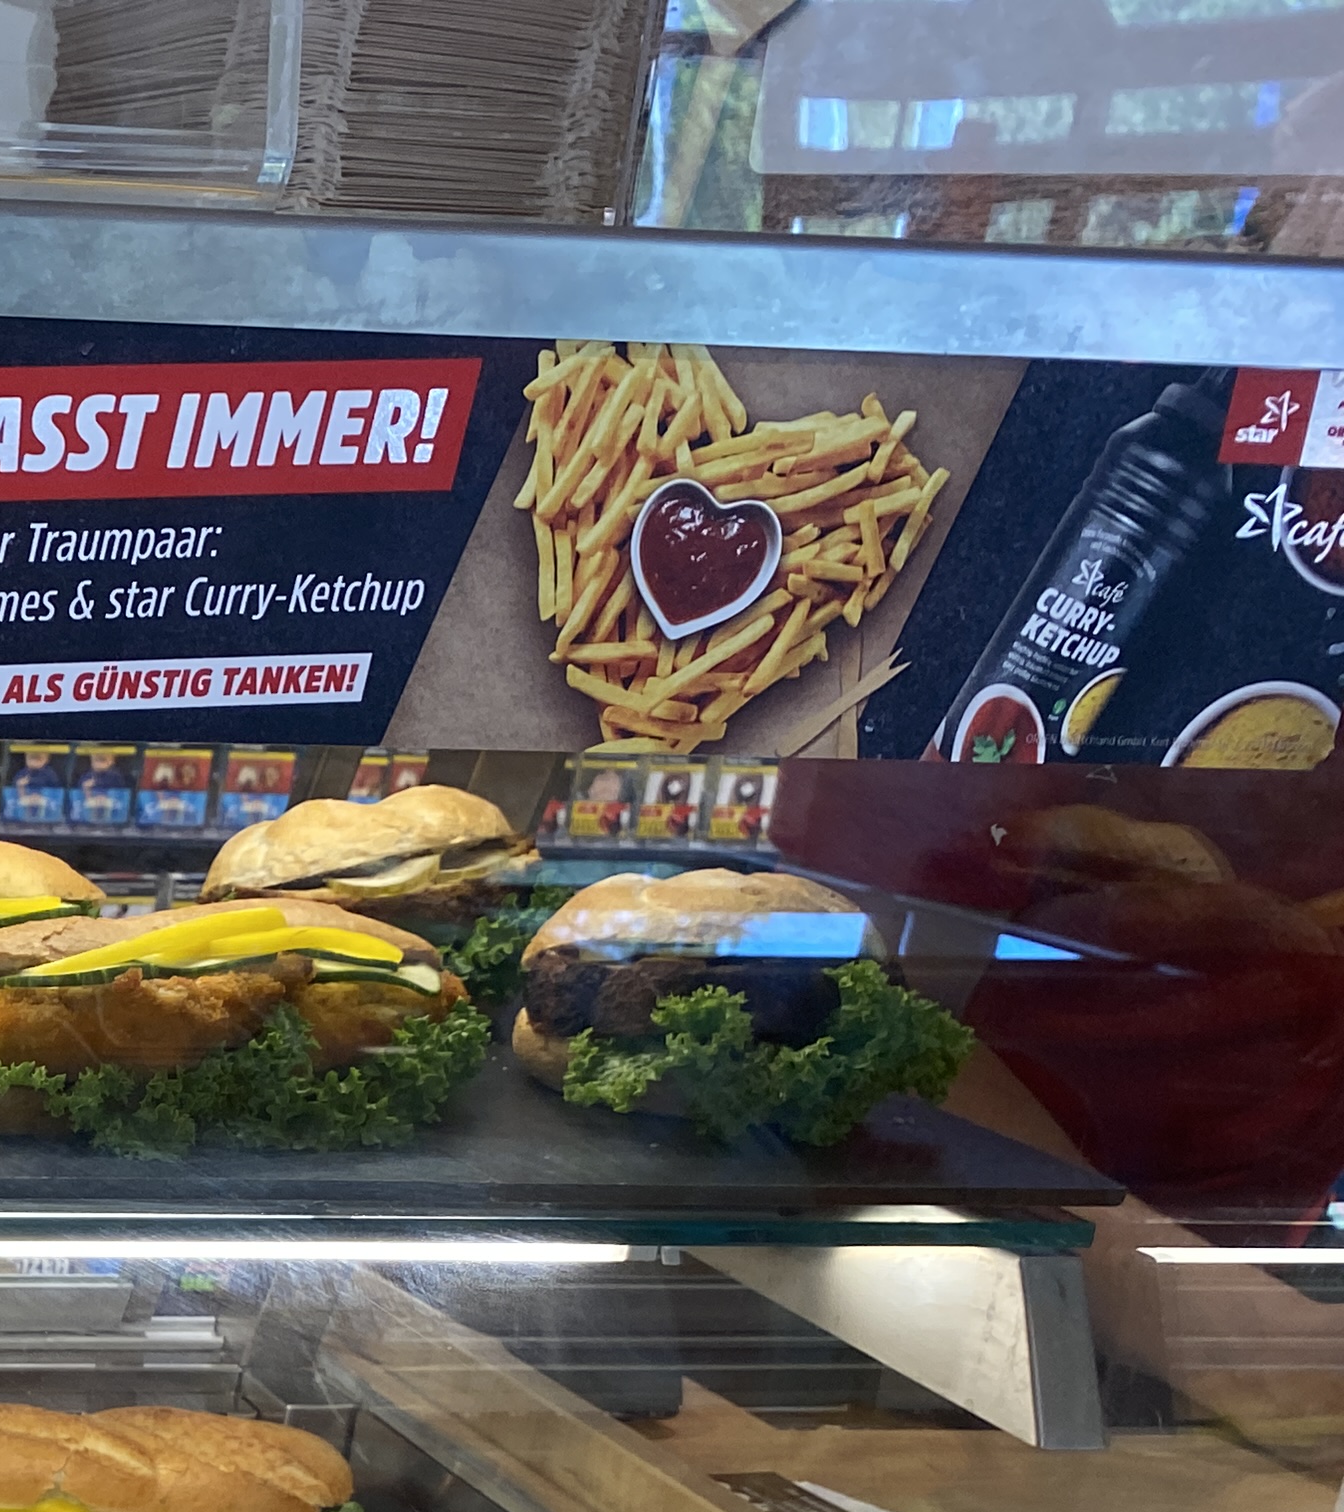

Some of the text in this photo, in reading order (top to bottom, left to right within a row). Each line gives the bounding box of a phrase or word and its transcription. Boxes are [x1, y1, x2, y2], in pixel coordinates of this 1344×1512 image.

[166, 387, 449, 469] IMMER!
[1234, 424, 1279, 444] star
[27, 522, 223, 567] Traumpaar:
[1287, 512, 1344, 564] caf
[68, 579, 94, 620] &
[104, 582, 176, 620] star
[183, 571, 426, 621] Curry-Ketchup
[1035, 586, 1116, 636] CURRY-
[1091, 581, 1129, 608] café
[1019, 613, 1121, 669] KETCHUP
[5, 673, 63, 704] ALS
[72, 665, 213, 701] GÜNSTIG
[221, 663, 360, 696] TANKEN!
